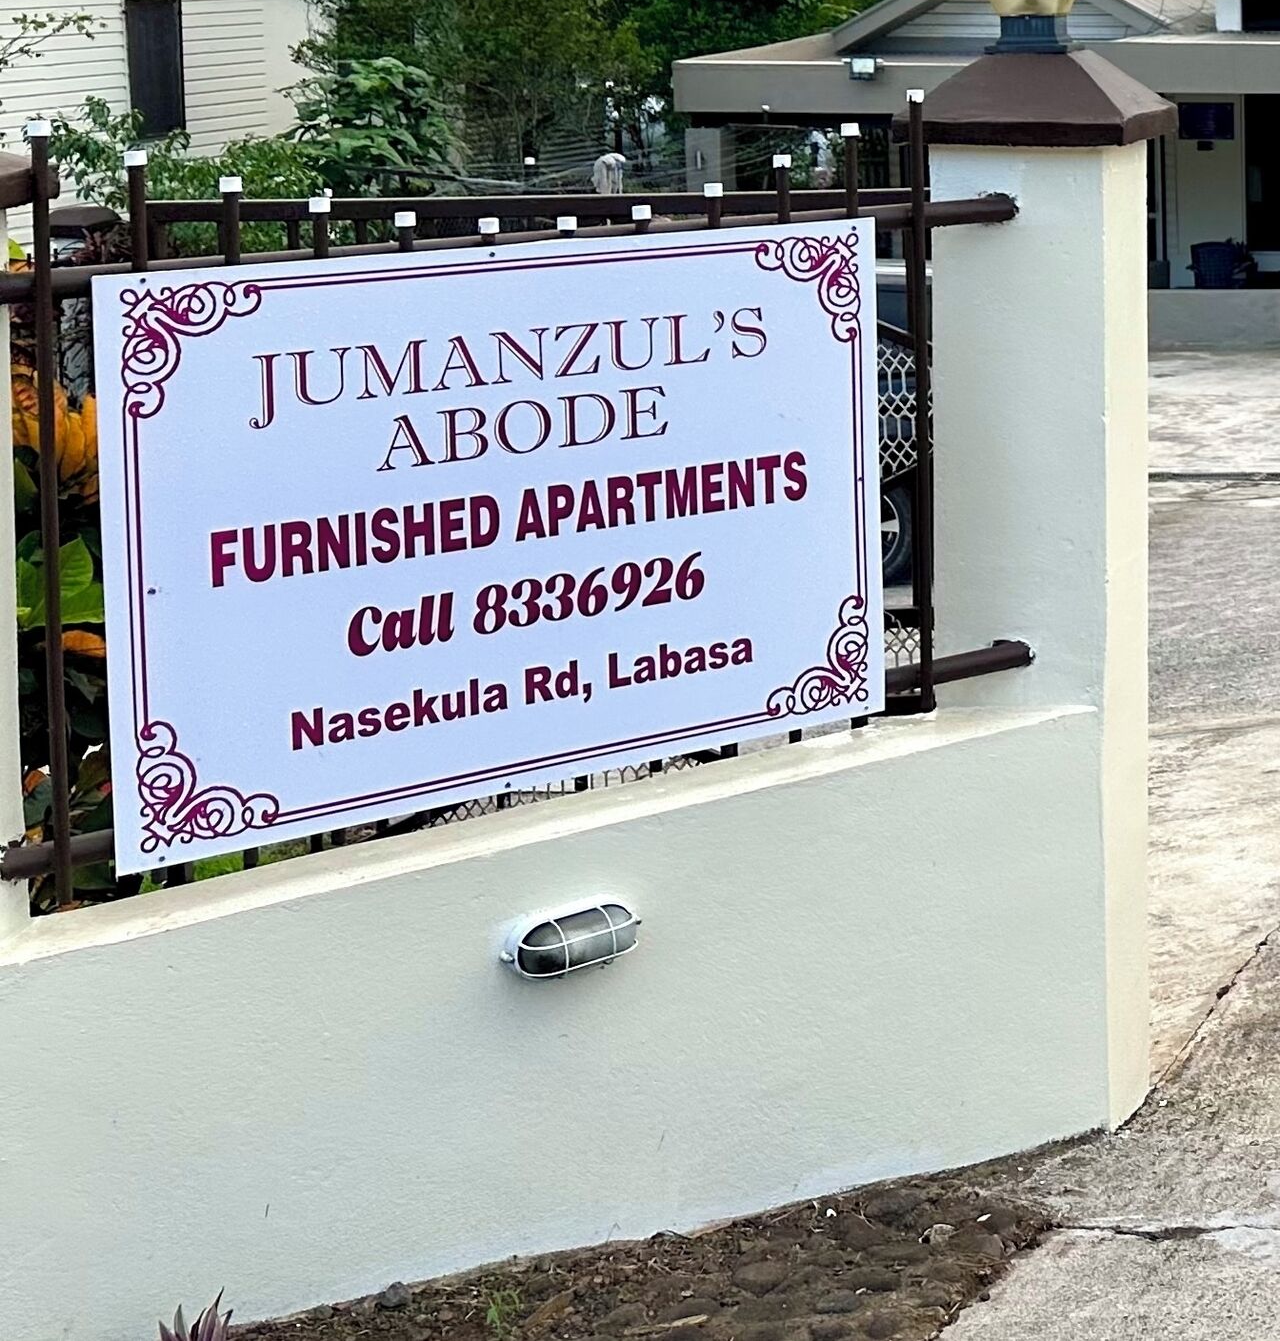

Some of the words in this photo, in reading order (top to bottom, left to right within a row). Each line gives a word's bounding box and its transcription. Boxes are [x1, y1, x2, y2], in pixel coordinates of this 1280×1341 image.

[248, 307, 768, 430] JUMANZUL'S
[376, 385, 669, 472] ABODE
[210, 494, 500, 589] FURNISHED
[515, 450, 808, 543] APARTMENTS
[347, 591, 455, 657] Call
[472, 551, 705, 635] 8336926
[291, 677, 509, 751] Nasekula
[525, 659, 592, 705] Rd,
[608, 637, 753, 690] Labasa
